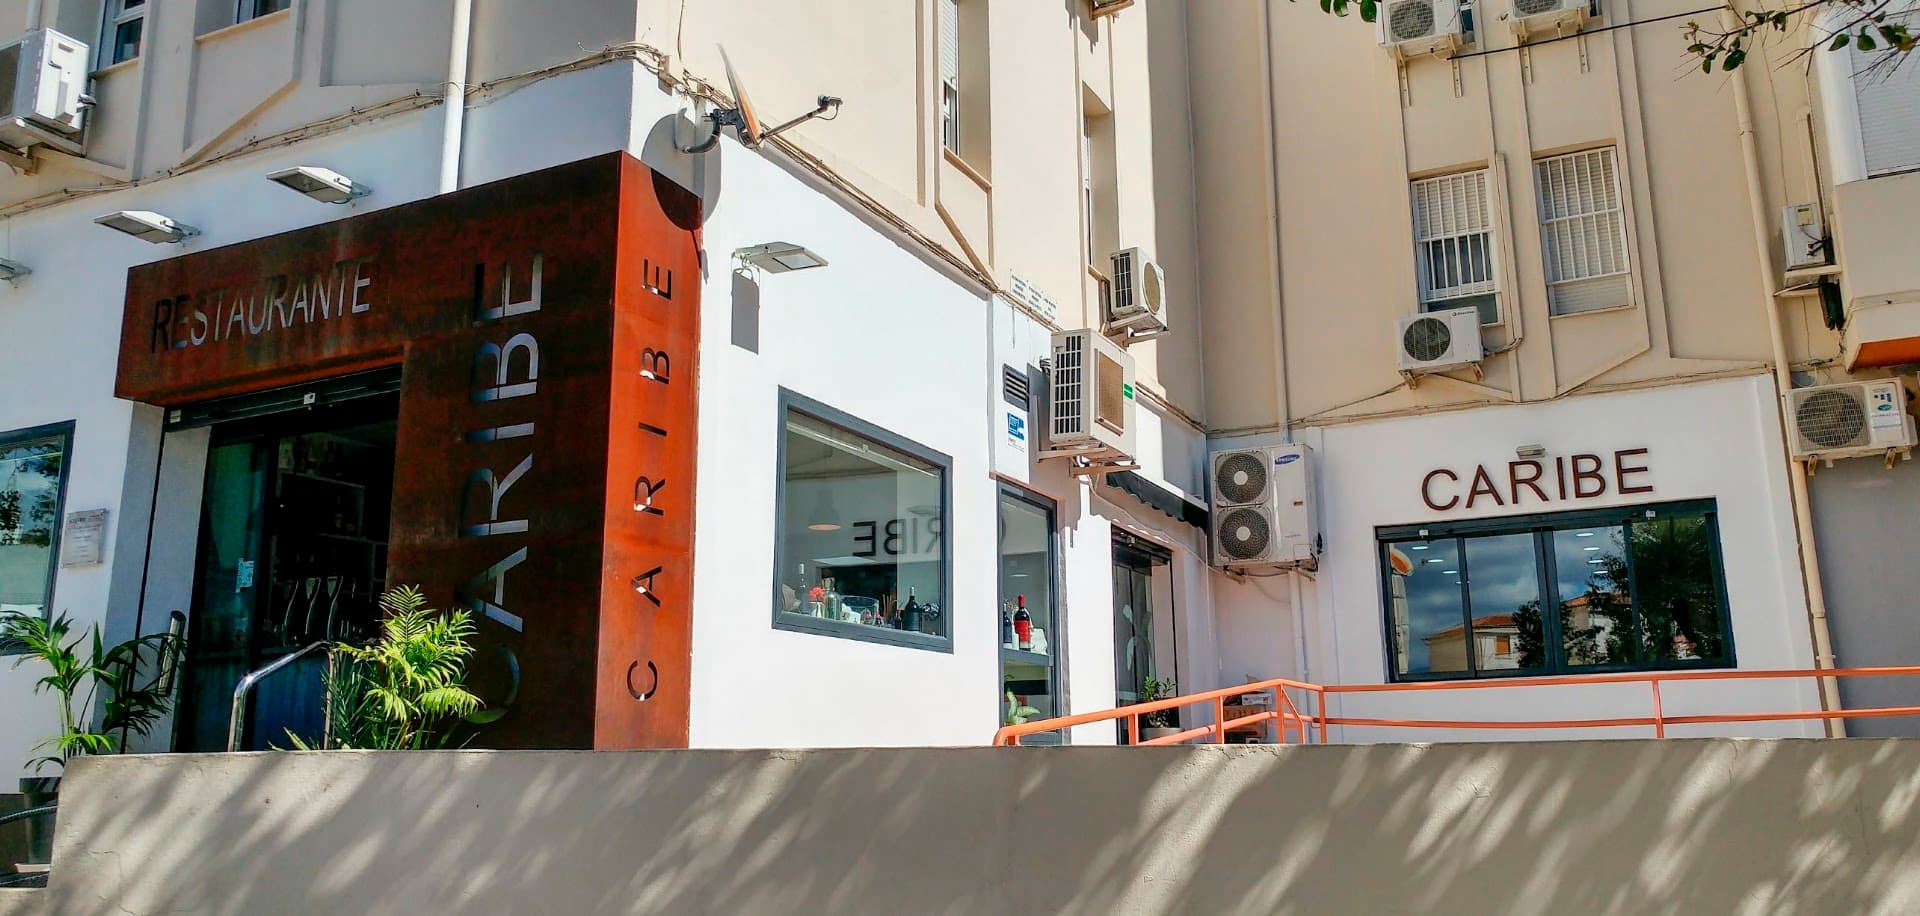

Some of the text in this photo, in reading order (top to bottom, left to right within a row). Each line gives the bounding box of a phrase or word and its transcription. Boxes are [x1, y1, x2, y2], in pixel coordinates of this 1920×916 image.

[152, 256, 374, 353] RESTAURANTE
[455, 253, 544, 724] CARIBE
[627, 257, 672, 702] CARIBE
[1421, 448, 1653, 512] CARIBE
